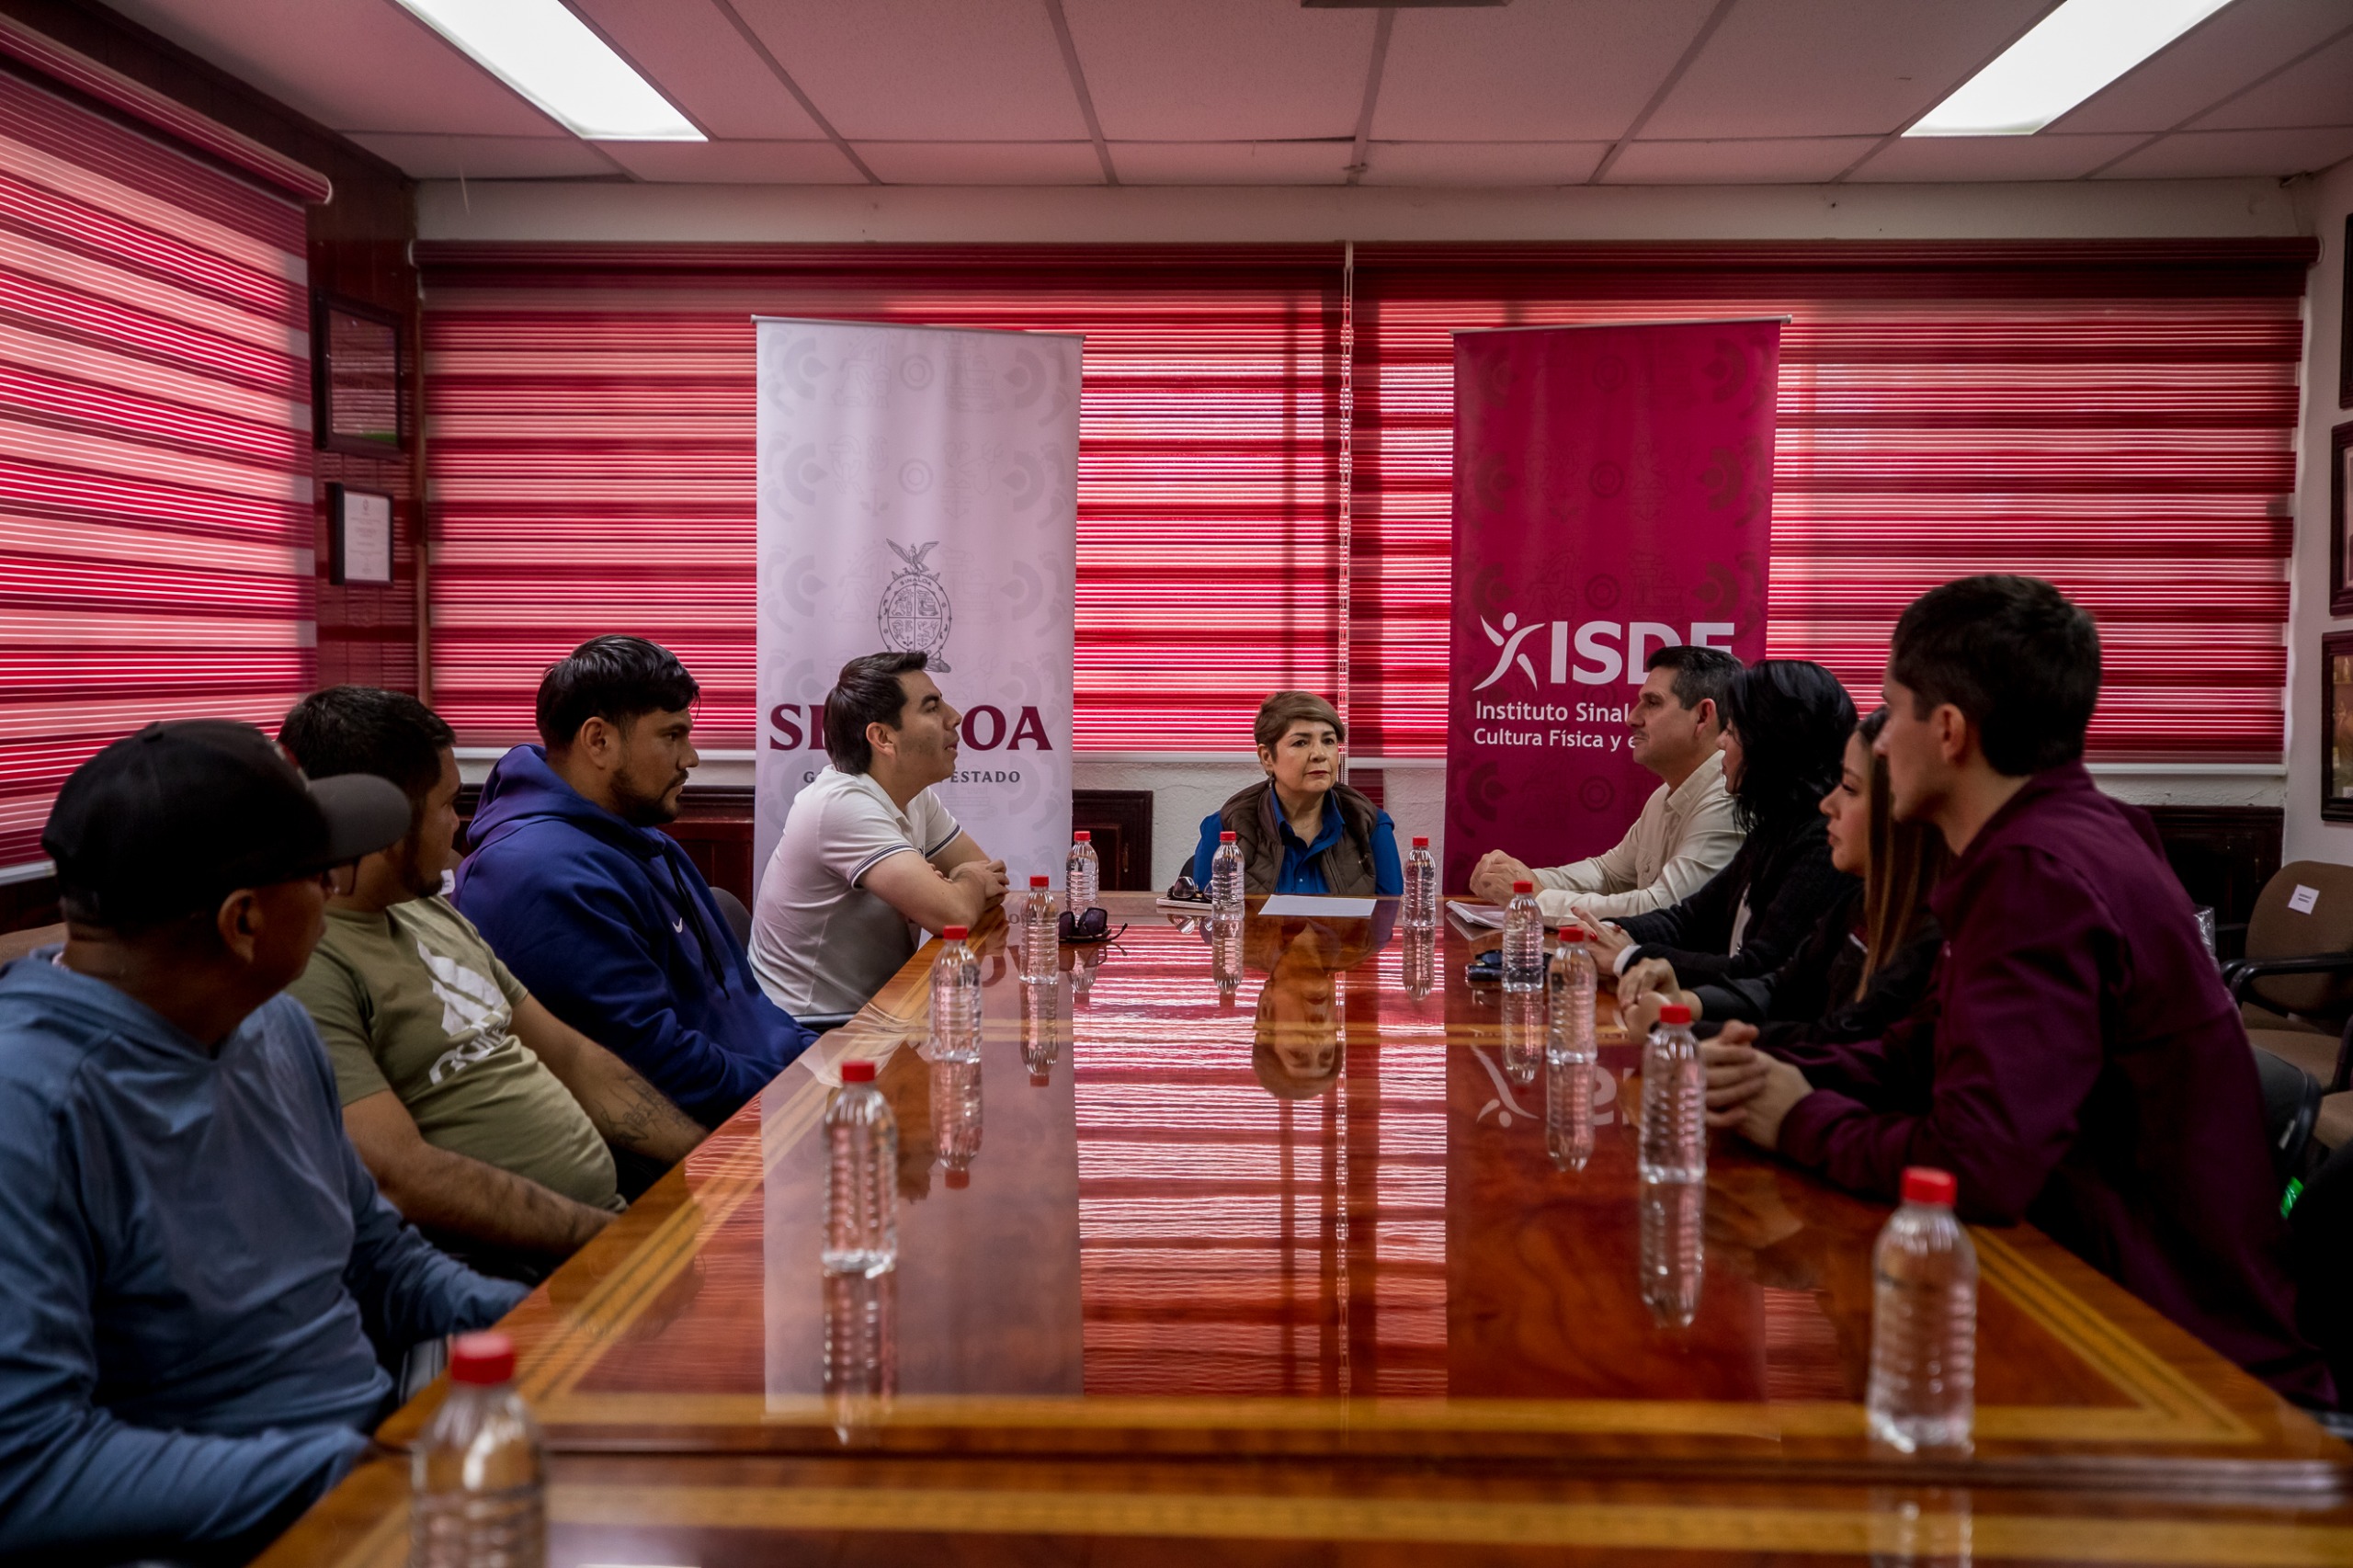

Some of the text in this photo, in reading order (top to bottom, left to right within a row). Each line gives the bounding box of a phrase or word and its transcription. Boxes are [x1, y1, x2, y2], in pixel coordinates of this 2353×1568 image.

[1475, 700, 1630, 722] Instituto Sinal
[769, 704, 1053, 751] SIOA
[1473, 728, 1542, 745] Cultura
[1549, 730, 1604, 747] Física
[1609, 735, 1621, 752] y
[950, 770, 1020, 783] ESTADO
